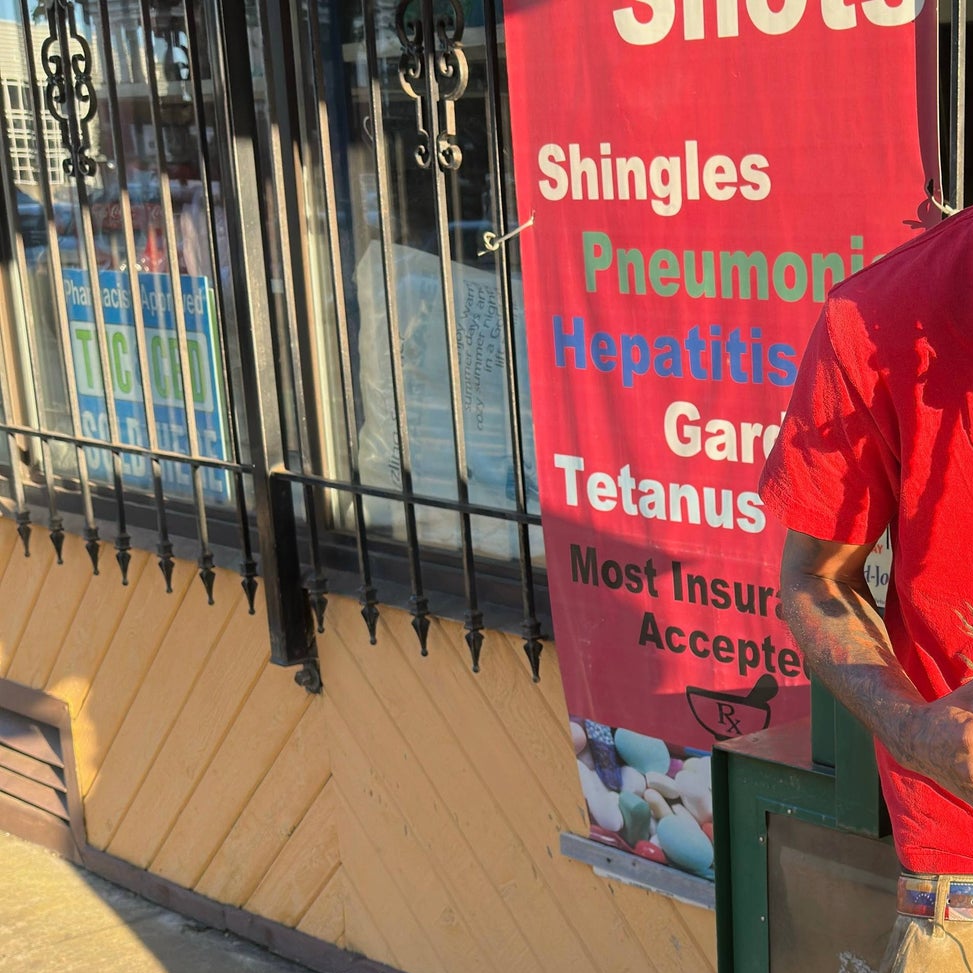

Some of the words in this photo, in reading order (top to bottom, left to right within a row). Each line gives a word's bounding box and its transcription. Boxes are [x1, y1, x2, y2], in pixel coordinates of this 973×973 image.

[537, 140, 772, 217] Shingles
[581, 231, 886, 304] Pneumoni
[552, 315, 799, 388] Hepatitis
[554, 453, 767, 534] Tetanus
[570, 543, 658, 598] Most
[638, 611, 812, 682] Accepte
